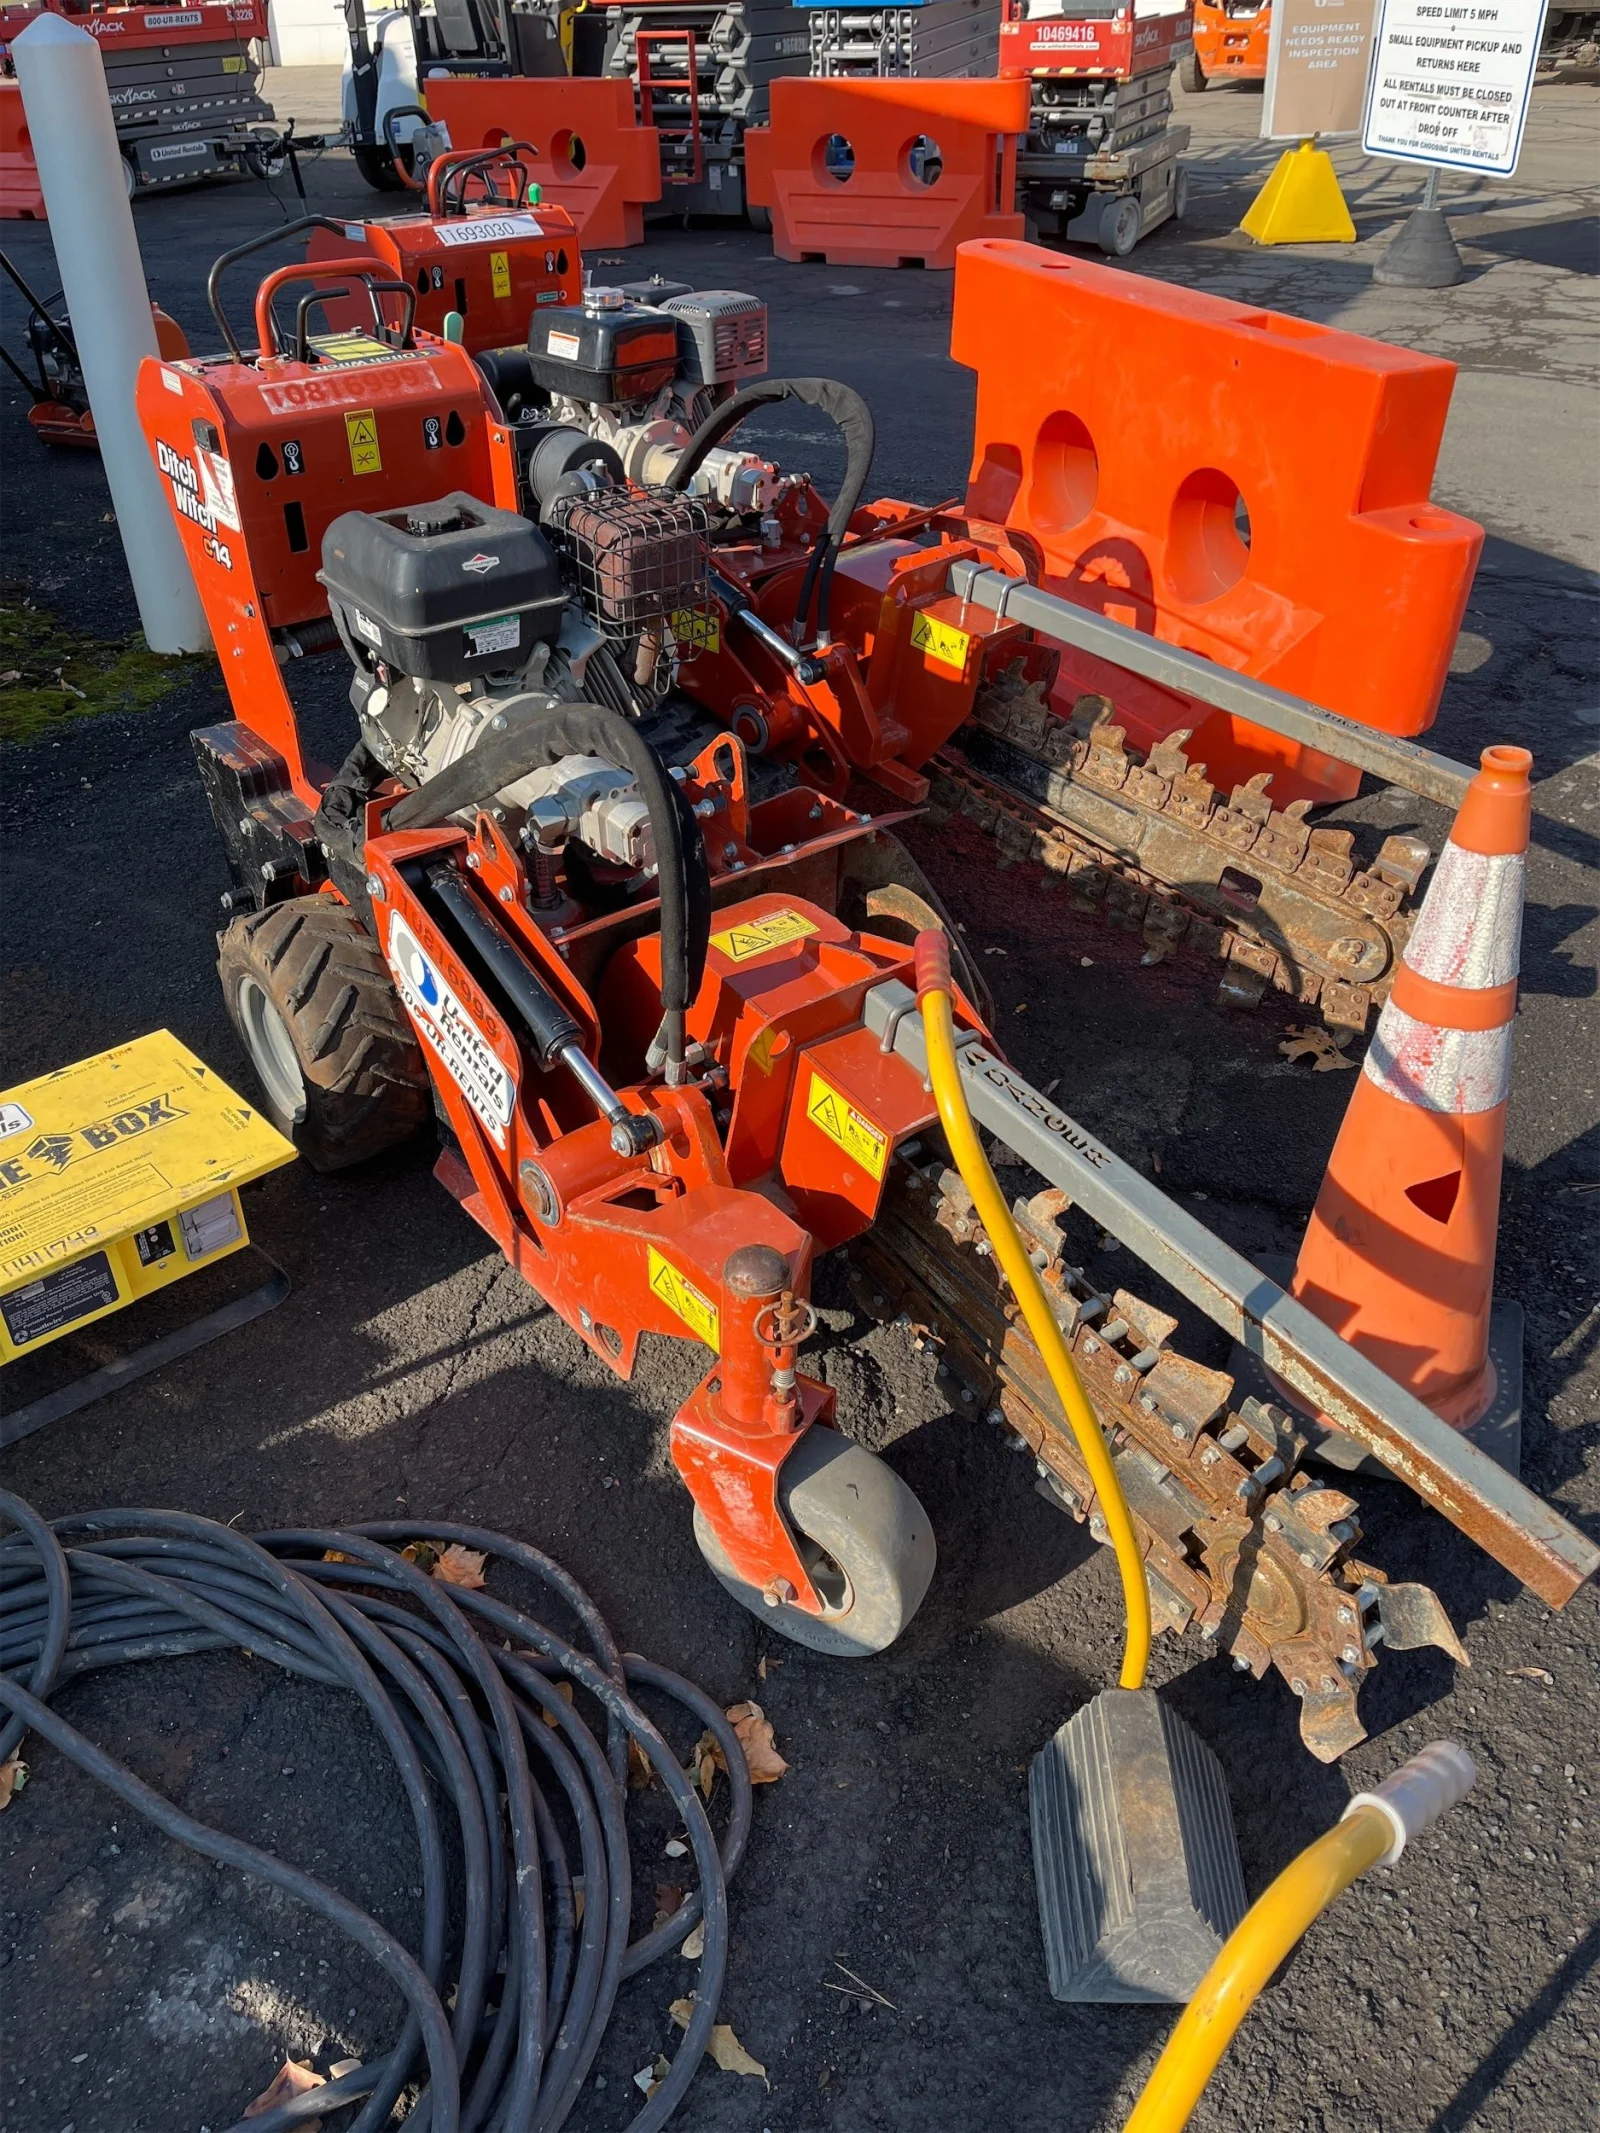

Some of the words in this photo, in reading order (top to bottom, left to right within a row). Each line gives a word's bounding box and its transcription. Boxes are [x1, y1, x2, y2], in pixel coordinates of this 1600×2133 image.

[147, 14, 199, 25] 800-UR-RENTS
[227, 8, 254, 21] S3226
[1416, 6, 1443, 18] SPEED
[1444, 8, 1469, 19] LIMIT
[1470, 9, 1476, 20] 5
[1478, 9, 1499, 21] MPH
[1036, 26, 1095, 41] 10469416
[1285, 36, 1325, 46] NEEDS
[1327, 34, 1366, 45] READY
[1292, 23, 1361, 34] EQUIPMENT
[1288, 47, 1360, 59] INSPECTION
[1388, 34, 1414, 46] SMALL
[1415, 36, 1464, 51] EQUIPMENT
[1465, 40, 1500, 53] PICKUP
[1501, 42, 1522, 54] AND
[1308, 60, 1338, 69] AREA
[1416, 57, 1455, 71] RETURNS
[1456, 60, 1481, 73] HERE
[1383, 78, 1398, 89] ALL
[1399, 80, 1435, 94] RENTALS
[1436, 84, 1461, 97] MUST
[1462, 87, 1474, 99] BE
[1475, 89, 1513, 103] CLOSED
[1379, 97, 1397, 108] OUT
[1396, 100, 1408, 110] AT
[1408, 101, 1437, 115] FRONT
[1437, 106, 1479, 120] COUNTER
[1480, 111, 1511, 124] AFTER
[1418, 123, 1441, 136] DROP
[1442, 126, 1459, 138] OFF
[161, 147, 181, 157] United
[1378, 134, 1396, 144] THANK
[1397, 138, 1408, 146] YOU
[1408, 139, 1419, 147] FOR
[1420, 141, 1449, 153] CHOOSING
[1449, 146, 1471, 156] UNITED
[1472, 149, 1500, 161] RENTALS
[437, 221, 515, 244] 11693030
[266, 368, 420, 408] 10816999
[156, 437, 199, 494] Ditch
[172, 480, 218, 535] Witch
[203, 536, 233, 571] C14
[401, 892, 499, 1039] 10816999
[440, 1012, 505, 1111] Rentals
[79, 1098, 176, 1151] BOX
[856, 1115, 884, 1143] DANGER
[984, 1069, 1112, 1169] DANGER
[14, 1198, 40, 1213] Suitable
[50, 1180, 84, 1197] Continuous
[21, 1315, 45, 1329] Portable
[45, 1307, 62, 1318] Power
[62, 1294, 93, 1311] Distribution
